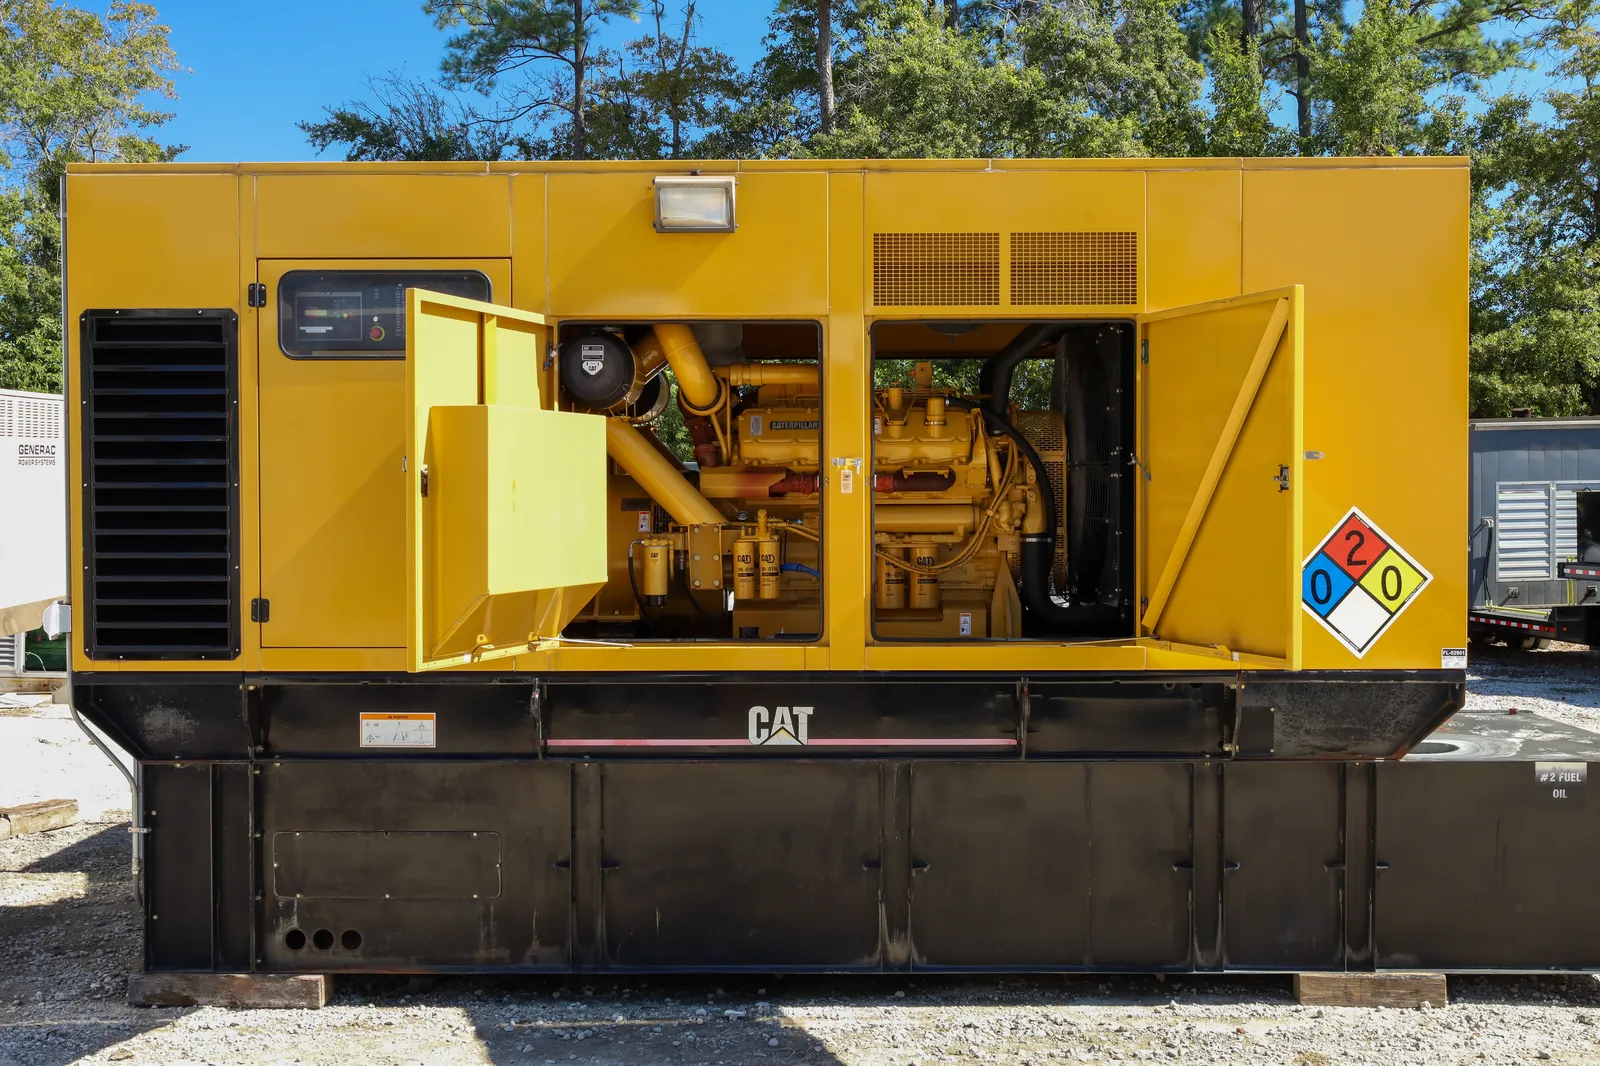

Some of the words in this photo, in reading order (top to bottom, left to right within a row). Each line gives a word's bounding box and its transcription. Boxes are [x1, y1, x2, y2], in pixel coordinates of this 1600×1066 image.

[19, 444, 56, 455] GENERAC
[1345, 530, 1366, 566] 2
[917, 556, 932, 565] CAT
[1310, 569, 1332, 604] 0
[1381, 566, 1402, 601] 0
[749, 706, 813, 745] CAT
[1540, 773, 1556, 782] #2
[1559, 773, 1581, 782] FUEL
[1552, 789, 1567, 798] OIL
